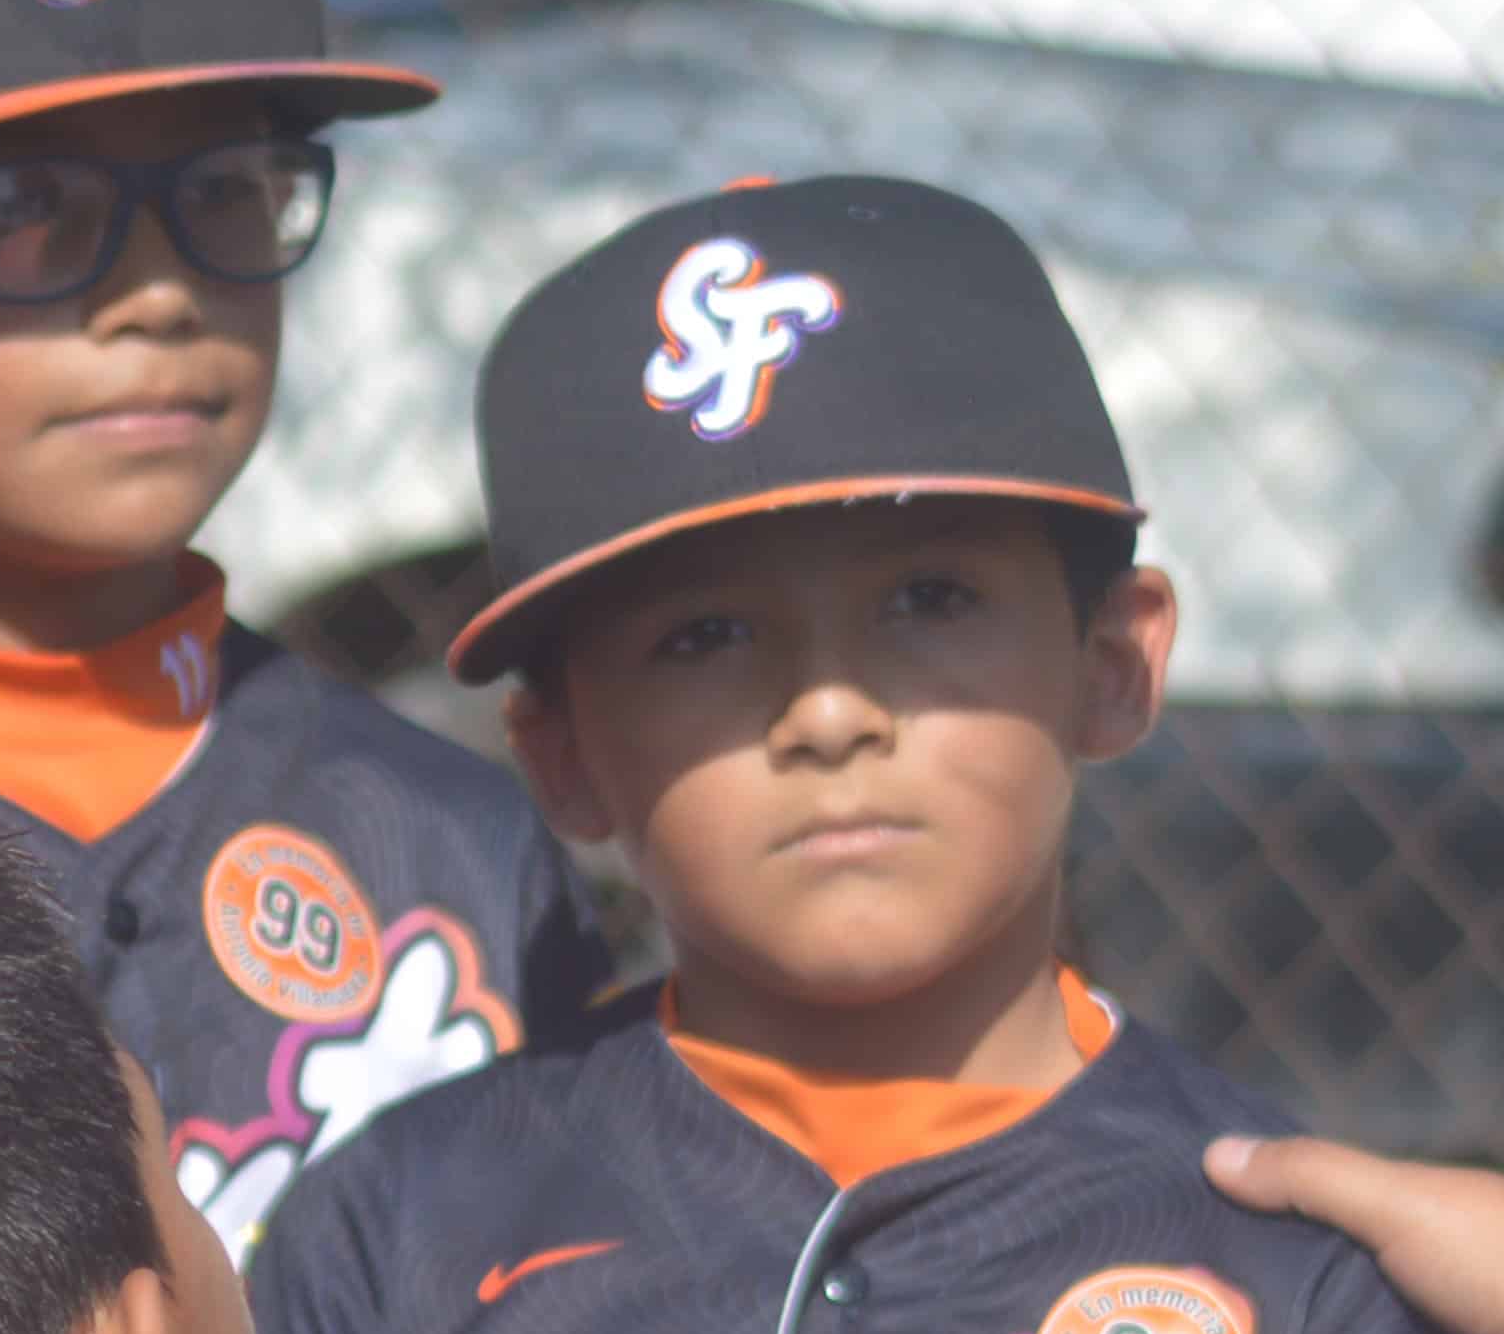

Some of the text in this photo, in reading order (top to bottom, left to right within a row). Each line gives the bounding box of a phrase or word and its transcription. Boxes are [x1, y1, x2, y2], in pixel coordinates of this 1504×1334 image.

[644, 235, 842, 441] SF
[251, 878, 342, 975] 99
[1078, 1293, 1113, 1320] En
